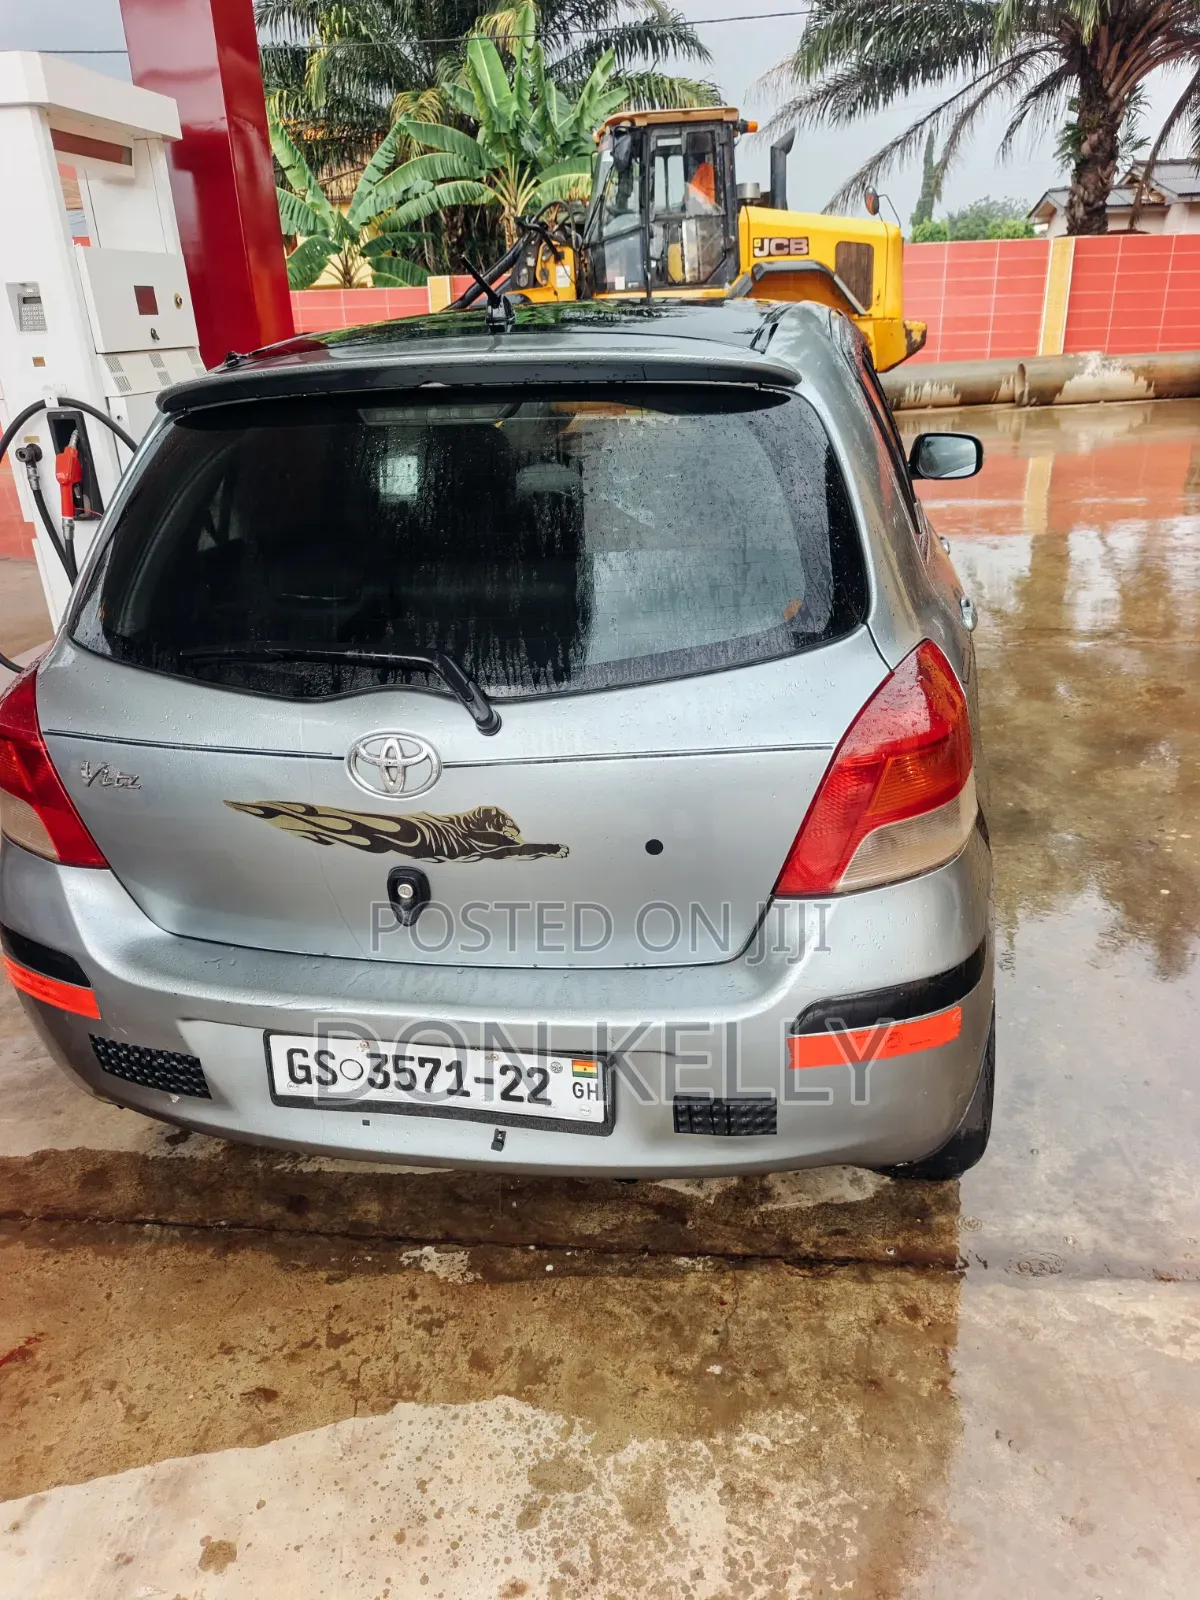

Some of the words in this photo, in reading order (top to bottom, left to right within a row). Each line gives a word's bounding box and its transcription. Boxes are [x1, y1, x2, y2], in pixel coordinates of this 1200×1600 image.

[753, 237, 809, 257] JCB
[286, 1047, 338, 1086] GS
[366, 1053, 552, 1106] 3571-22
[572, 1081, 600, 1101] GH
